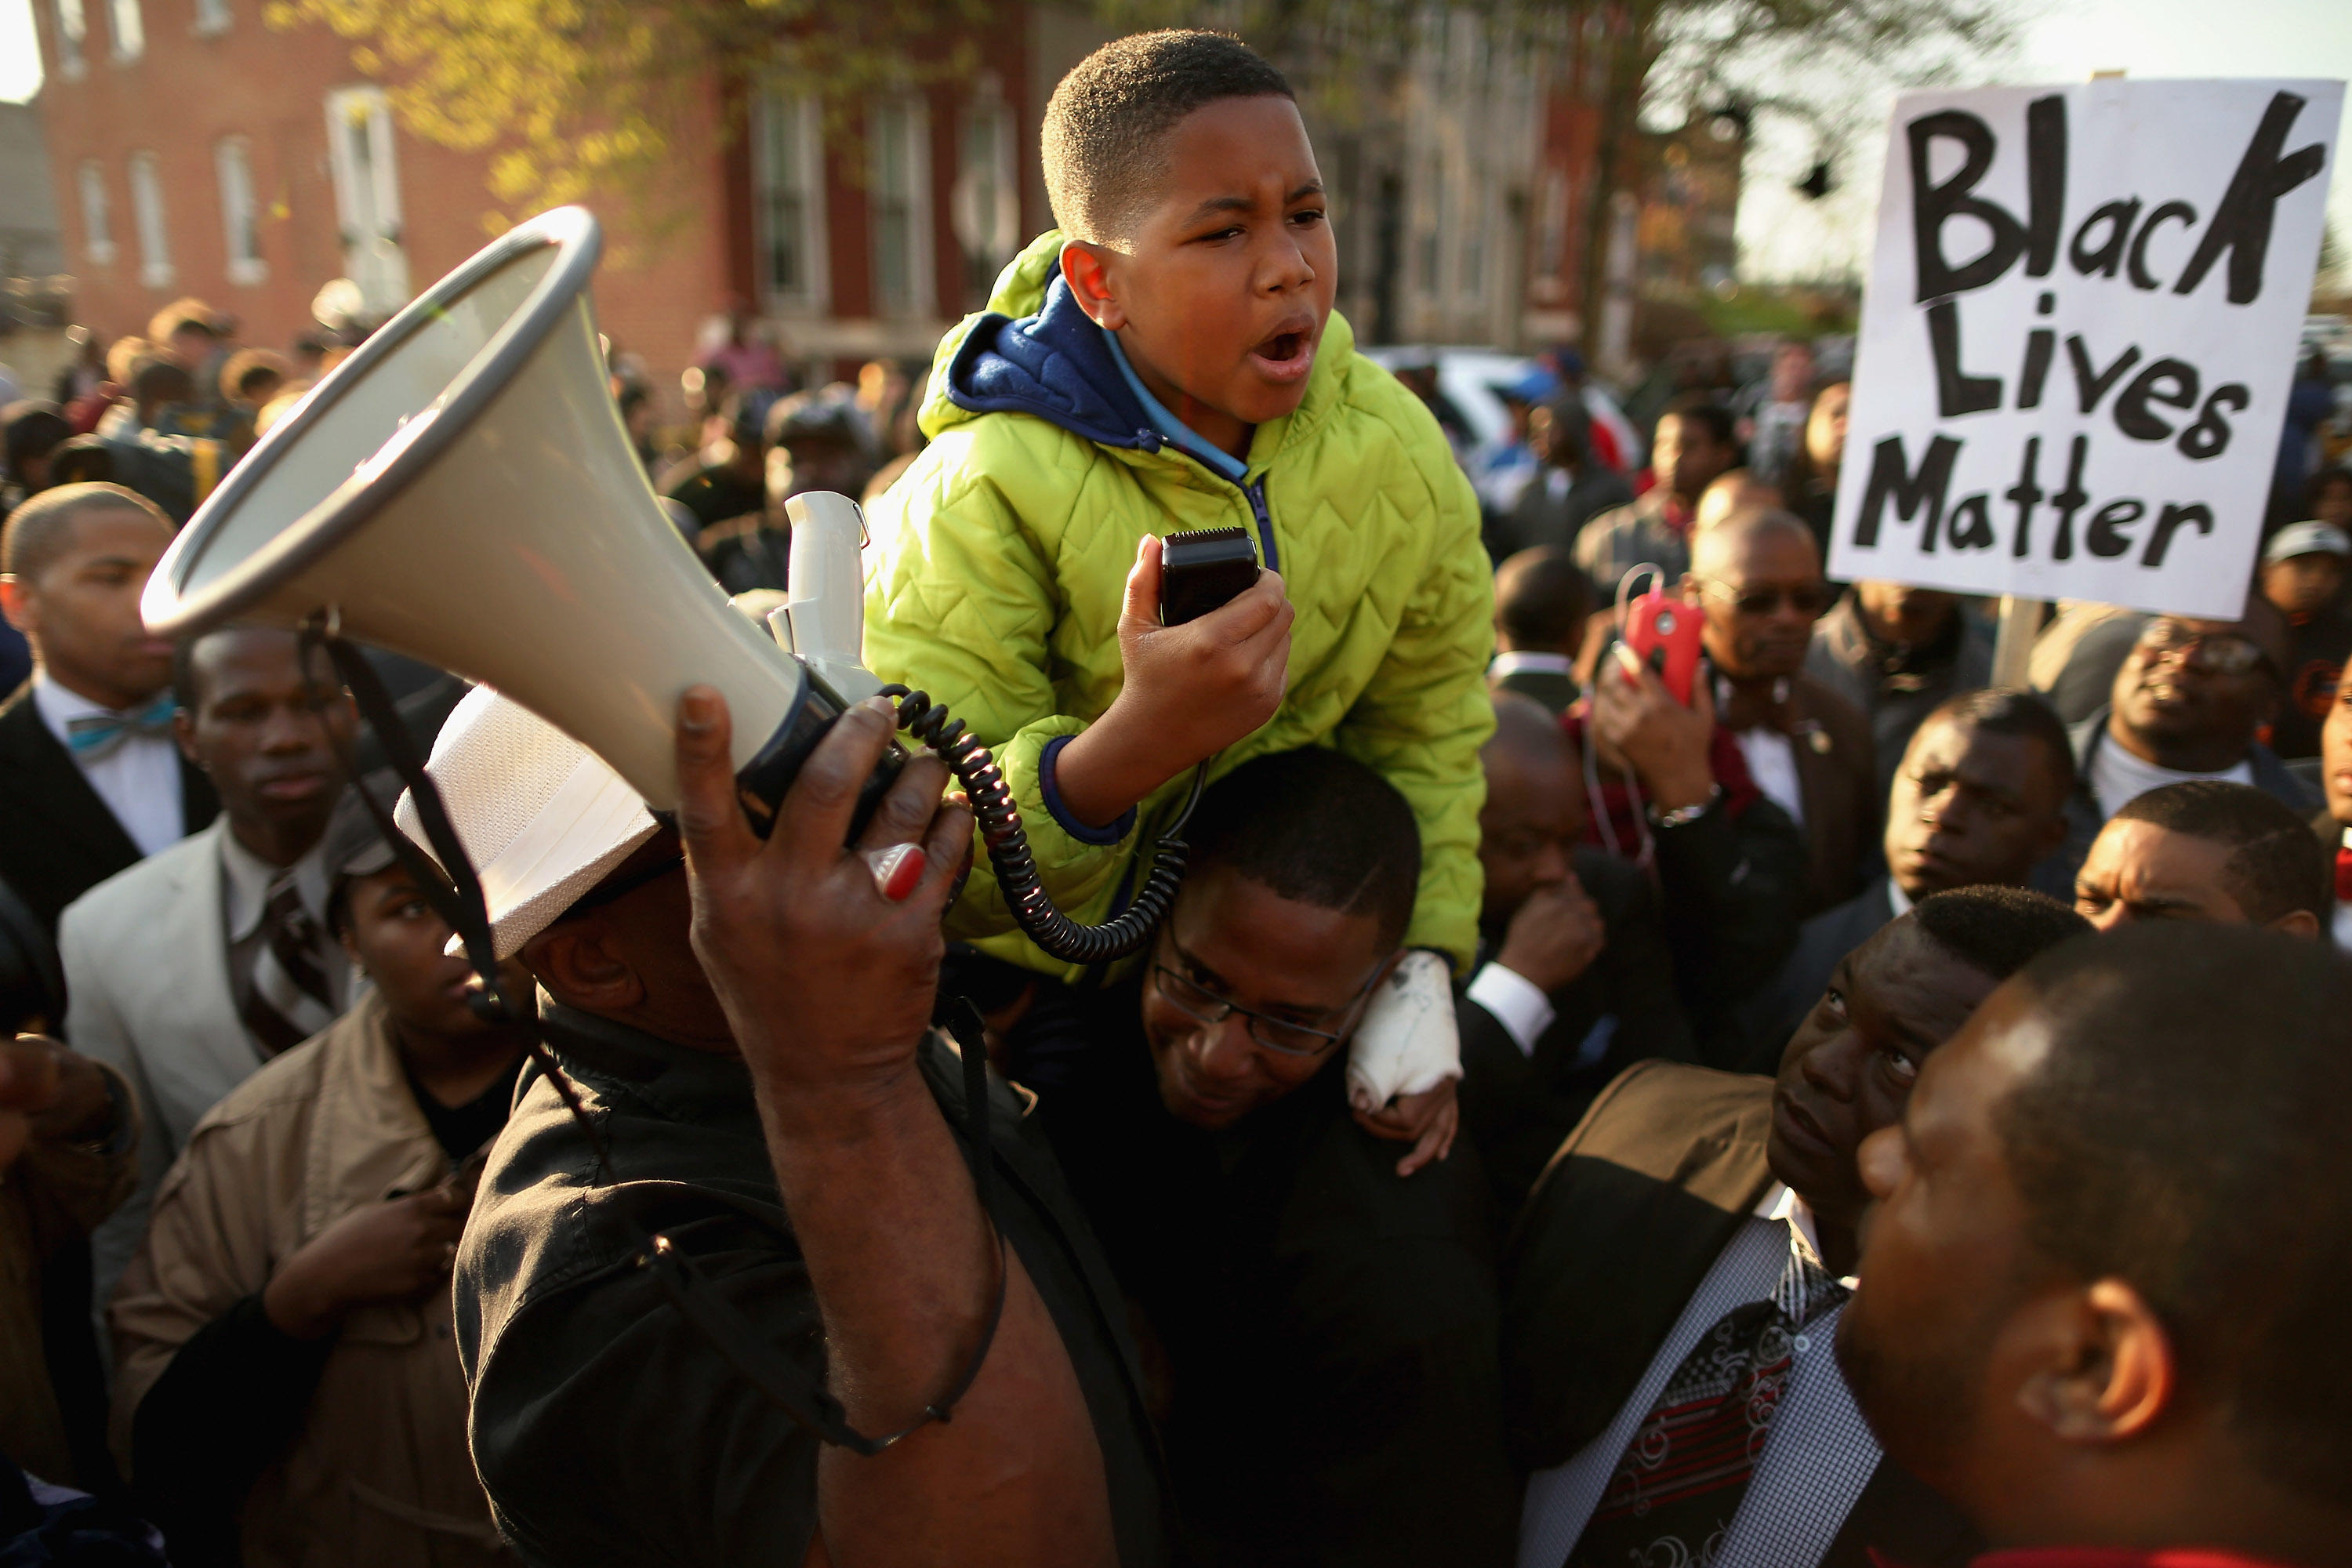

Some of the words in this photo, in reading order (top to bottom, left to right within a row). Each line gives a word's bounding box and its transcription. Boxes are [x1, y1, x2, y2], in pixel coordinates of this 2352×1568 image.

[1905, 90, 2326, 306] Black
[1925, 292, 2250, 460] Lives
[1852, 434, 2215, 568] Matter
